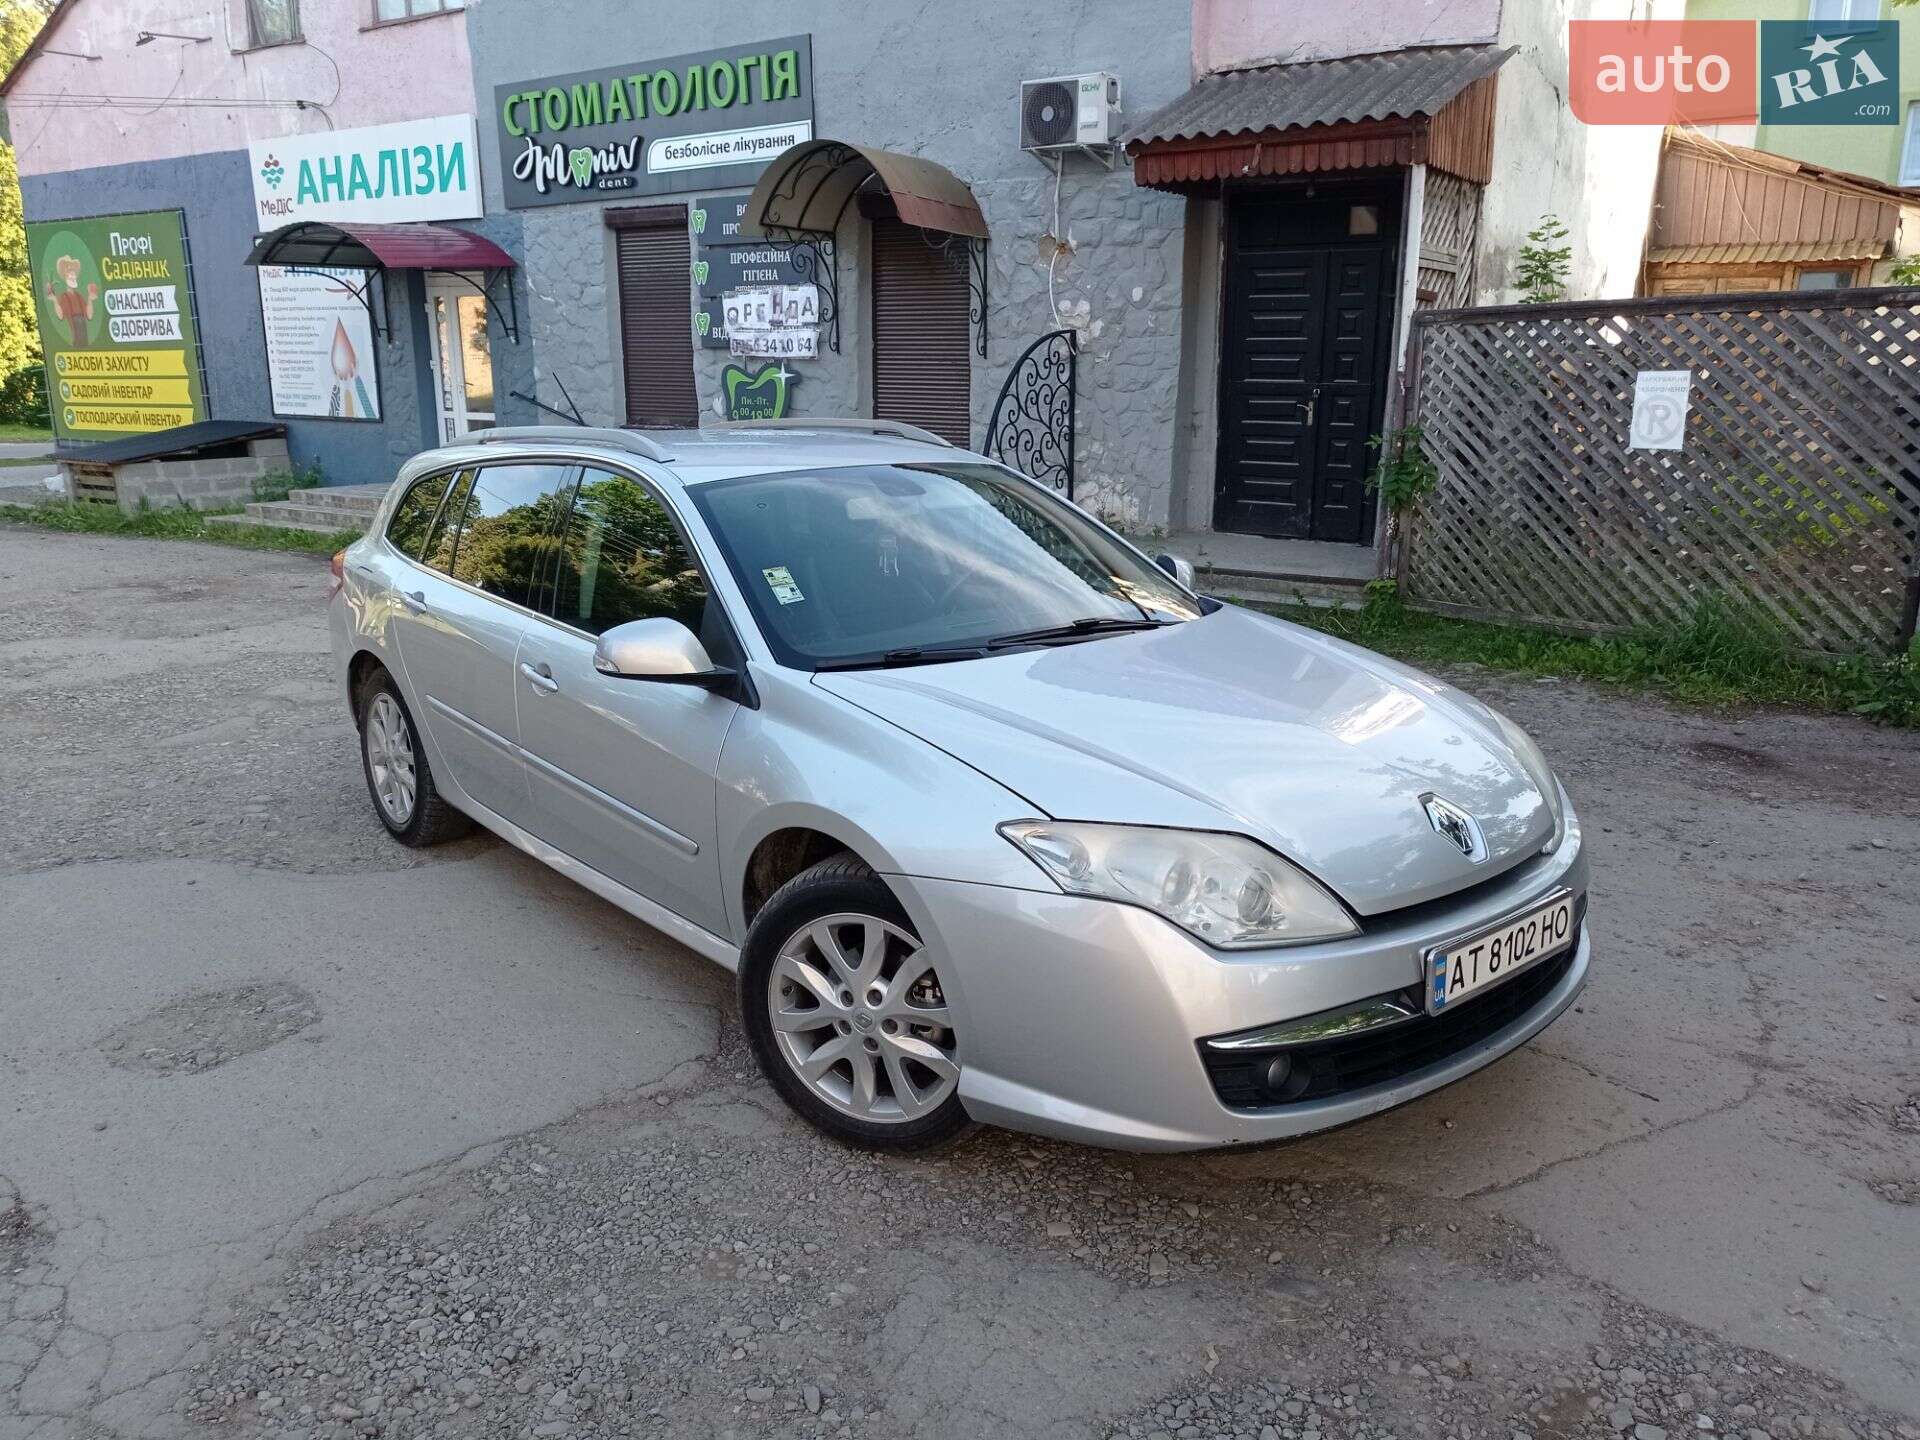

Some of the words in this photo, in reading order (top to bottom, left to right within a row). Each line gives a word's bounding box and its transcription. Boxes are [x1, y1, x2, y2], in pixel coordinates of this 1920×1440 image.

[503, 49, 800, 136] СТОМАТОЛОГІЯ
[664, 140, 731, 160] безболісне
[733, 133, 796, 154] лікування
[297, 142, 466, 205] АНАЛІЗИ
[599, 177, 628, 188] dent
[730, 248, 791, 264] ПРОФЕСІЙНА
[743, 269, 779, 281] ГІГІЄНА
[115, 292, 165, 310] НАСІННЯ
[121, 319, 175, 338] ДОБРИВА
[66, 356, 103, 372] ЗАСОБИ
[105, 356, 149, 372] ЗАХИСТУ
[71, 382, 111, 399] САДОВИЙ
[113, 386, 153, 400] ІНВЕНТАР
[76, 410, 141, 426] ГОСПОДАРСЬКИЙ
[143, 413, 182, 427] ІНВЕНТАР
[1450, 945, 1484, 994] AT
[1489, 921, 1536, 973] 8102
[1541, 905, 1568, 949] HO
[1434, 987, 1445, 1002] UA
